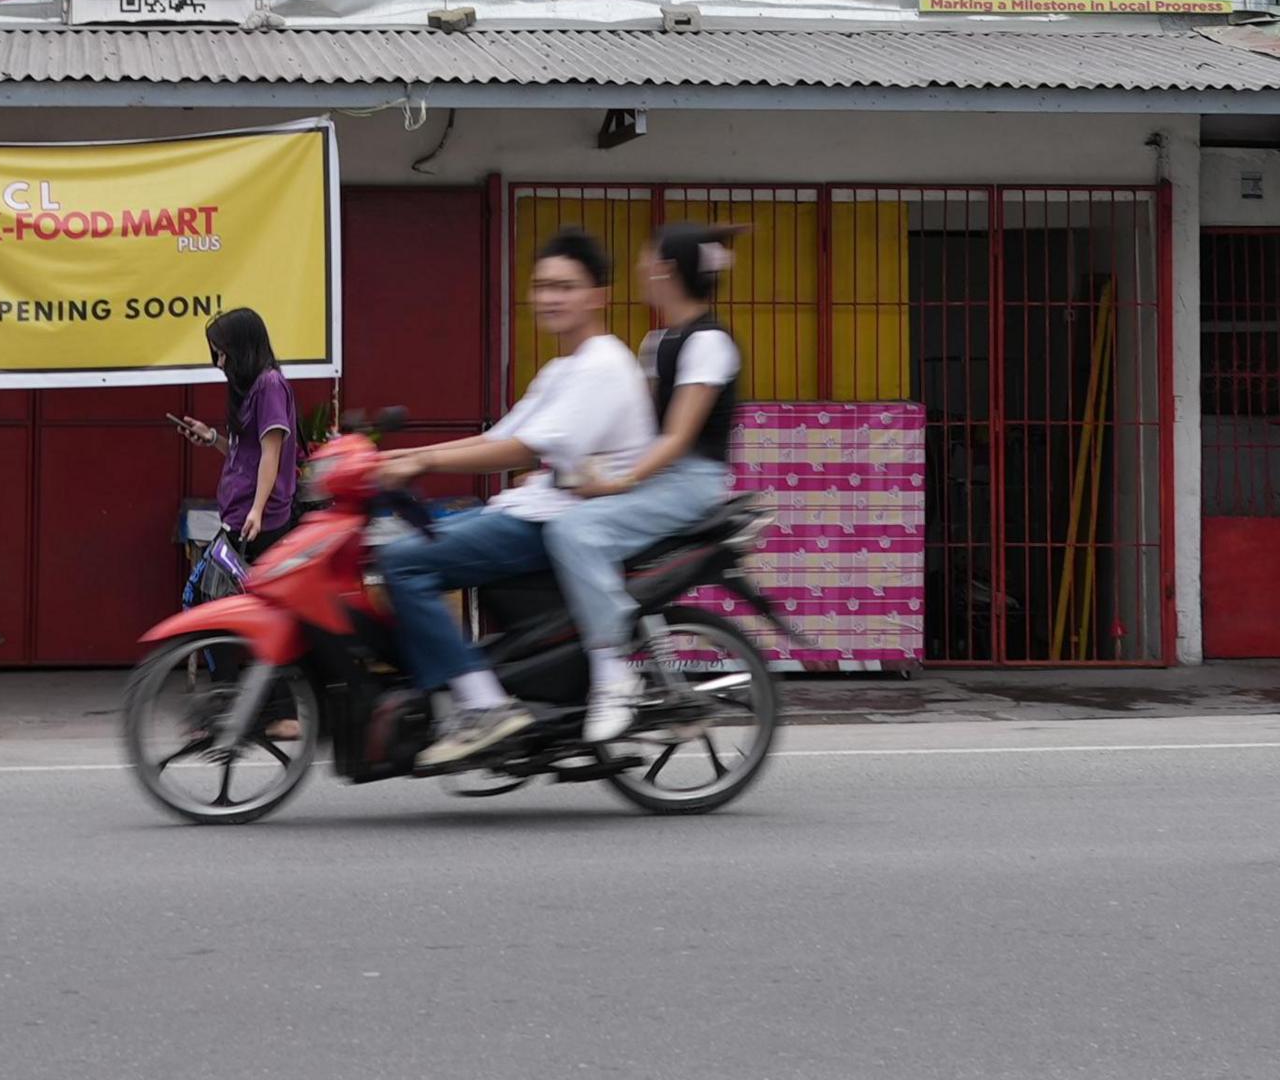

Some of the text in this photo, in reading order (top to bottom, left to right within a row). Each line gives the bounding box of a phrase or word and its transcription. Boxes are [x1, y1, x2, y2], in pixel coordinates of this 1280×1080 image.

[997, 1, 1007, 10] a
[1010, 0, 1086, 12] Milestone
[1090, 1, 1105, 12] in
[1108, 1, 1152, 12] Local
[1154, 1, 1224, 14] Progress
[120, 205, 219, 239] MART
[177, 235, 221, 252] PLUS
[124, 294, 223, 320] SOON!
